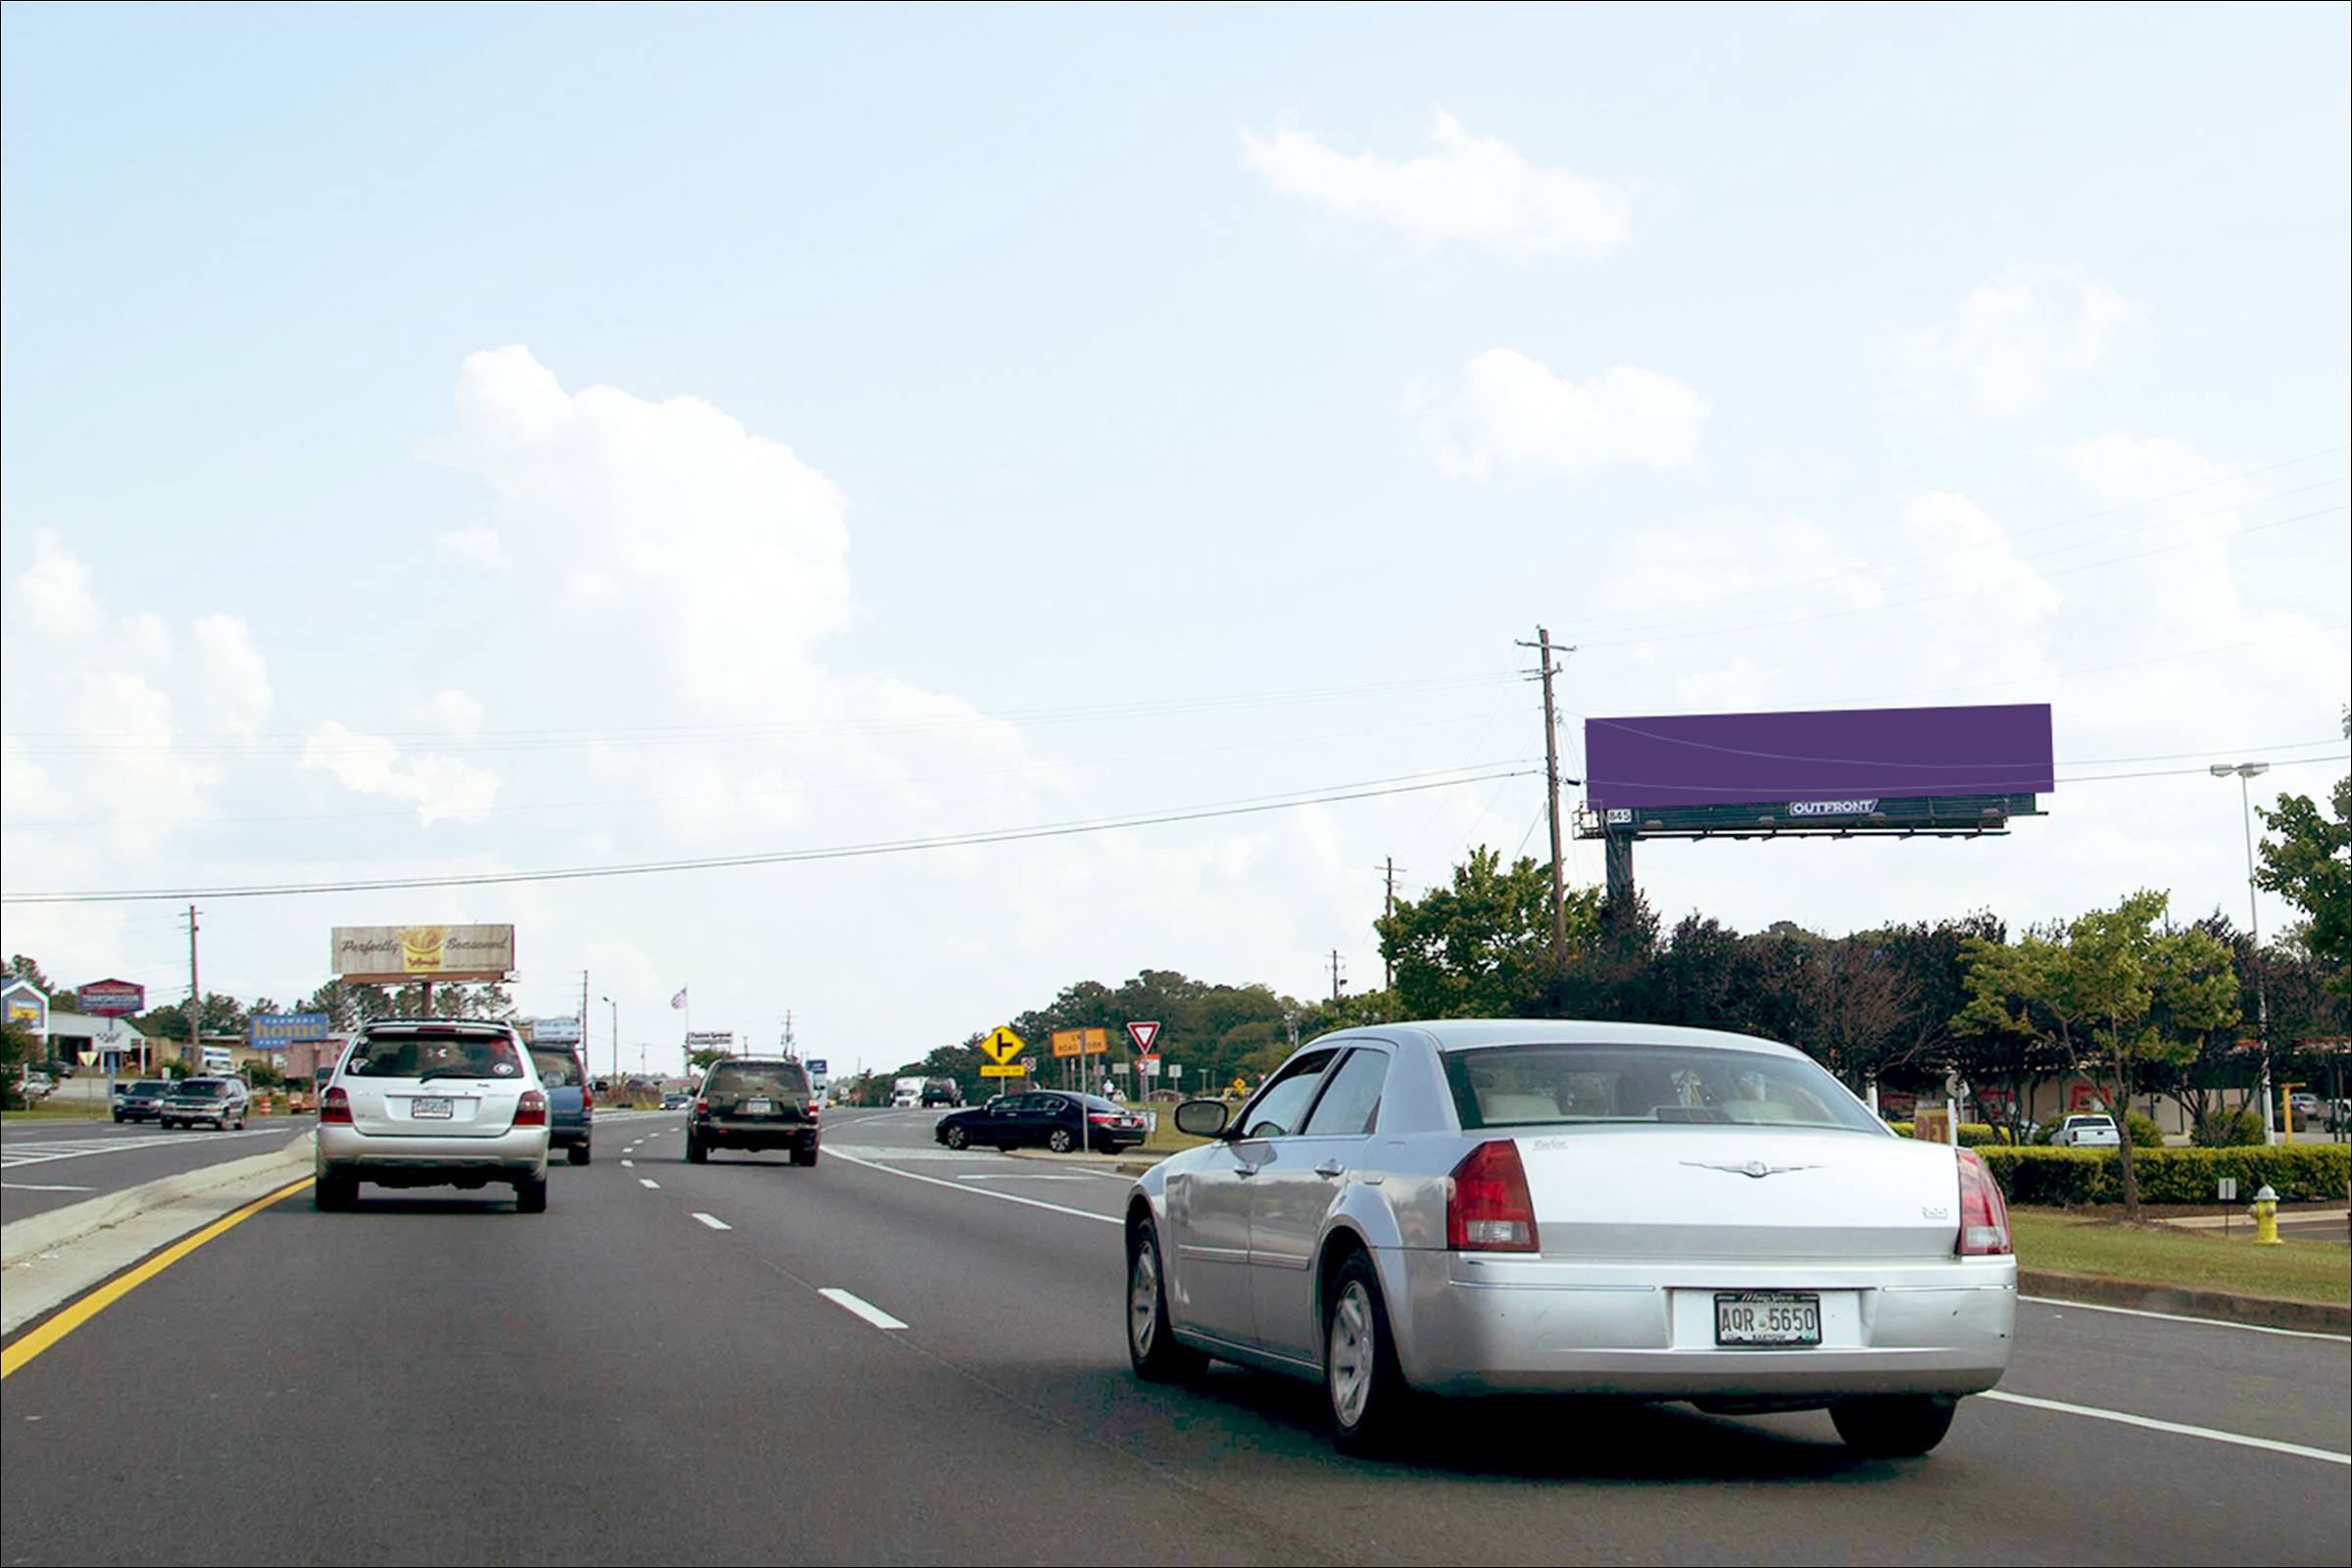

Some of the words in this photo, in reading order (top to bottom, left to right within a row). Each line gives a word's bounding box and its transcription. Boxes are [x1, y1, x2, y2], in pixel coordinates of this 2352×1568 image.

[1792, 800, 1874, 814] OUTFRONT
[341, 937, 400, 956] Perfectly
[446, 936, 508, 951] Seasoned
[255, 1018, 322, 1038] home
[1057, 1043, 1079, 1052] ROAD
[1722, 1307, 1754, 1332] AQR
[1769, 1307, 1815, 1332] 5650
